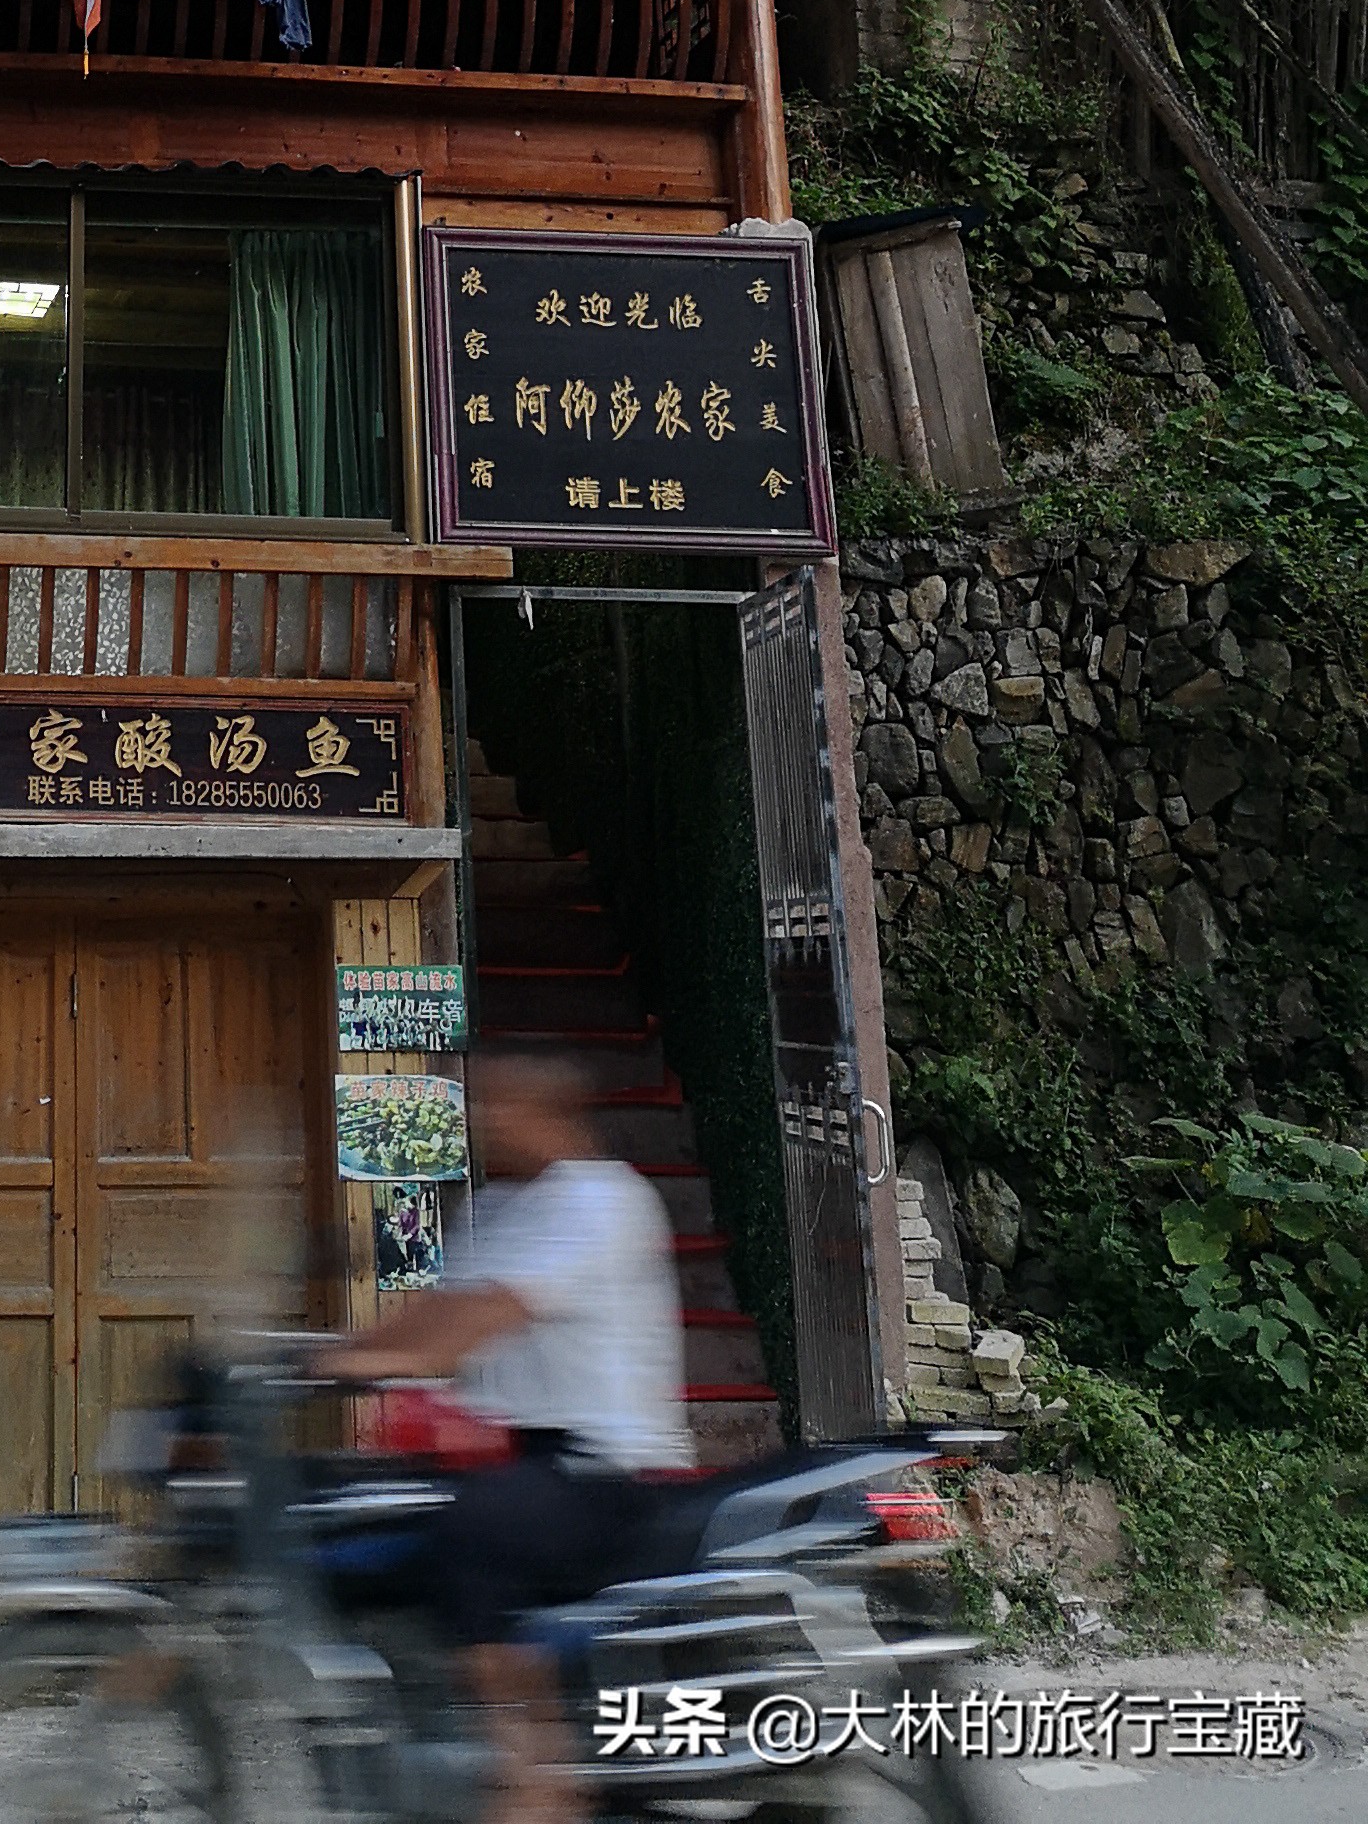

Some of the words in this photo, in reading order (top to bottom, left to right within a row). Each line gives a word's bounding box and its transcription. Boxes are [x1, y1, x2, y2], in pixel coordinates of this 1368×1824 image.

[535, 289, 703, 330] 欢迎光临
[460, 266, 496, 489] 农家住宿
[745, 277, 793, 498] 舌尖美食
[564, 476, 686, 512] 请上楼
[343, 970, 458, 991] 体验苗家高山流水
[351, 1080, 449, 1100] 苗家辣子鸡
